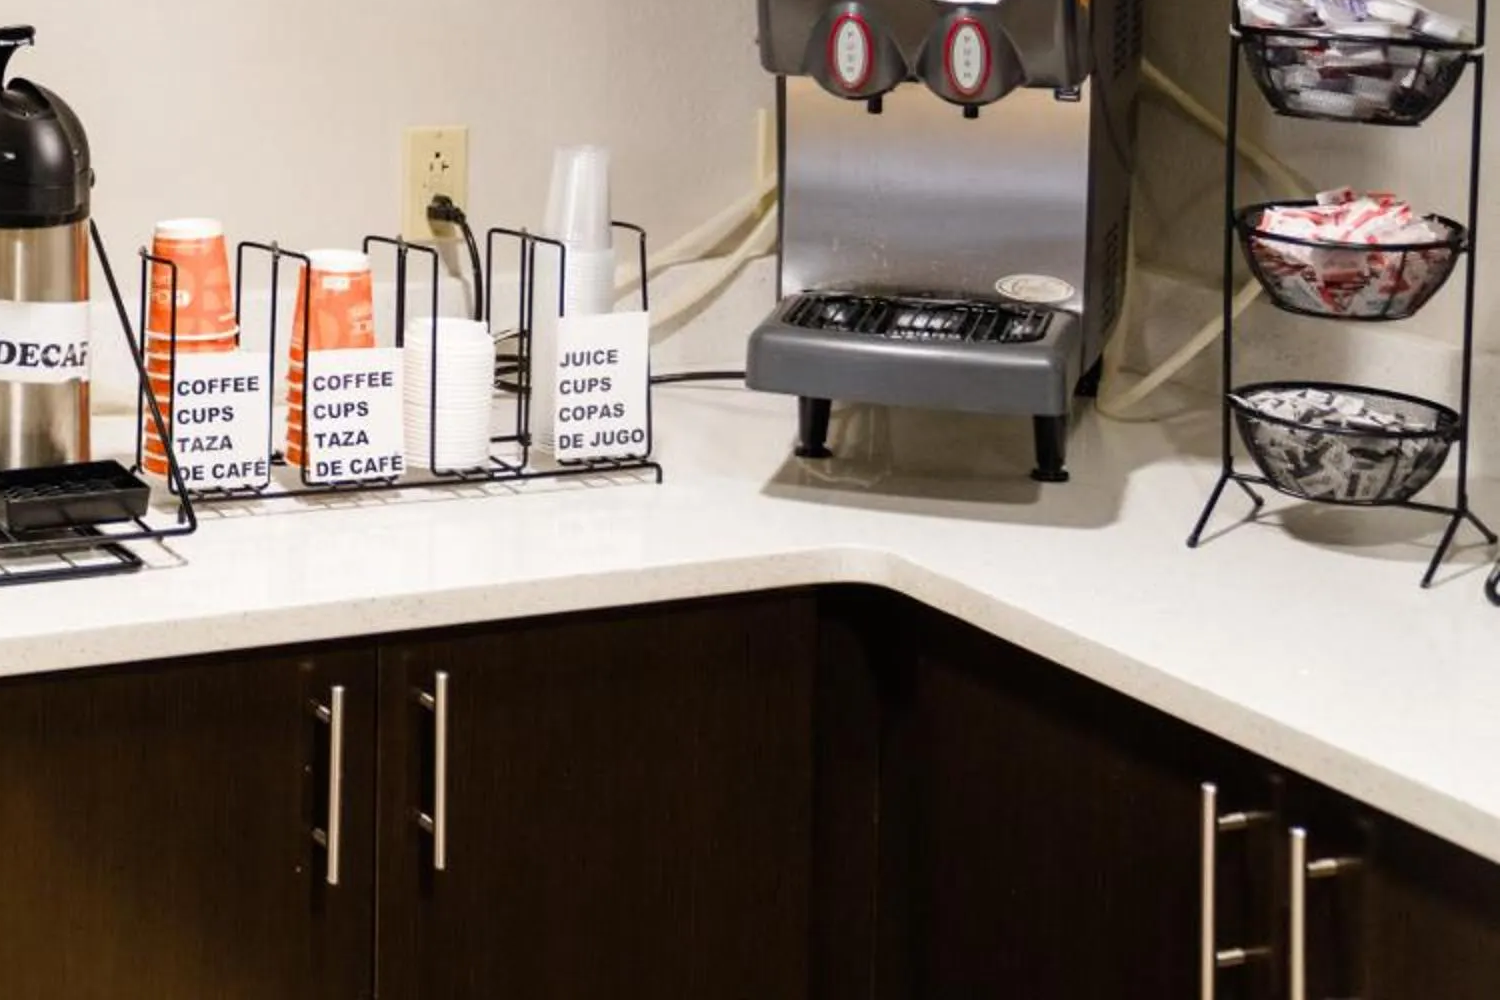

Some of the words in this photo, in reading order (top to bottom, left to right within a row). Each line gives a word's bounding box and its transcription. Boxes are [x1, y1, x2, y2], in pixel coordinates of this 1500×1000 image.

[559, 348, 619, 368] JUICE
[176, 375, 260, 396] COFFEE
[312, 371, 394, 392] COFFEE
[559, 377, 612, 396] CUPS
[176, 405, 235, 425] CUPS
[313, 401, 370, 420] CUPS
[558, 402, 626, 423] COPAS
[176, 435, 234, 453] TAZA
[313, 430, 370, 449] TAZA
[558, 433, 585, 450] DE
[589, 428, 645, 448] JUGO
[178, 465, 205, 481] DE
[316, 460, 343, 478] DE
